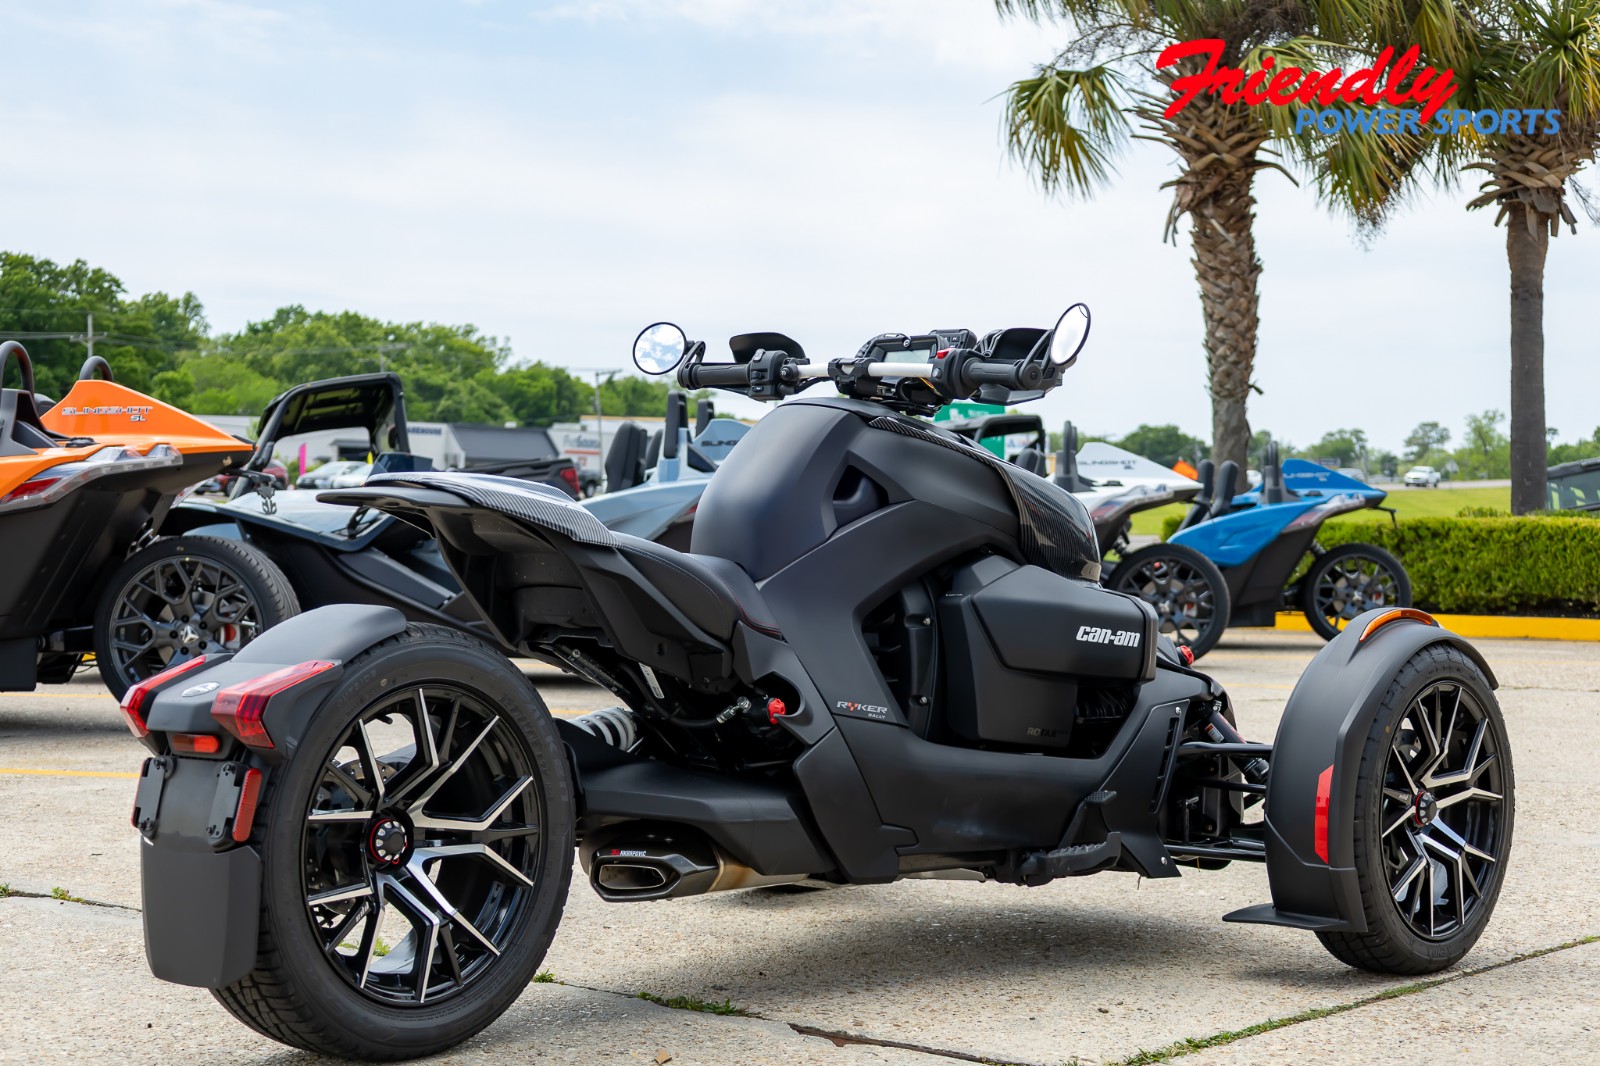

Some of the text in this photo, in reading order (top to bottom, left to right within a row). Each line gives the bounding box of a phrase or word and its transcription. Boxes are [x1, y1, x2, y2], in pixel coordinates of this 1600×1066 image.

[61, 406, 153, 416] SLINGSHOT
[130, 414, 147, 422] SL
[1076, 625, 1141, 648] can-am
[836, 700, 888, 714] RYKER
